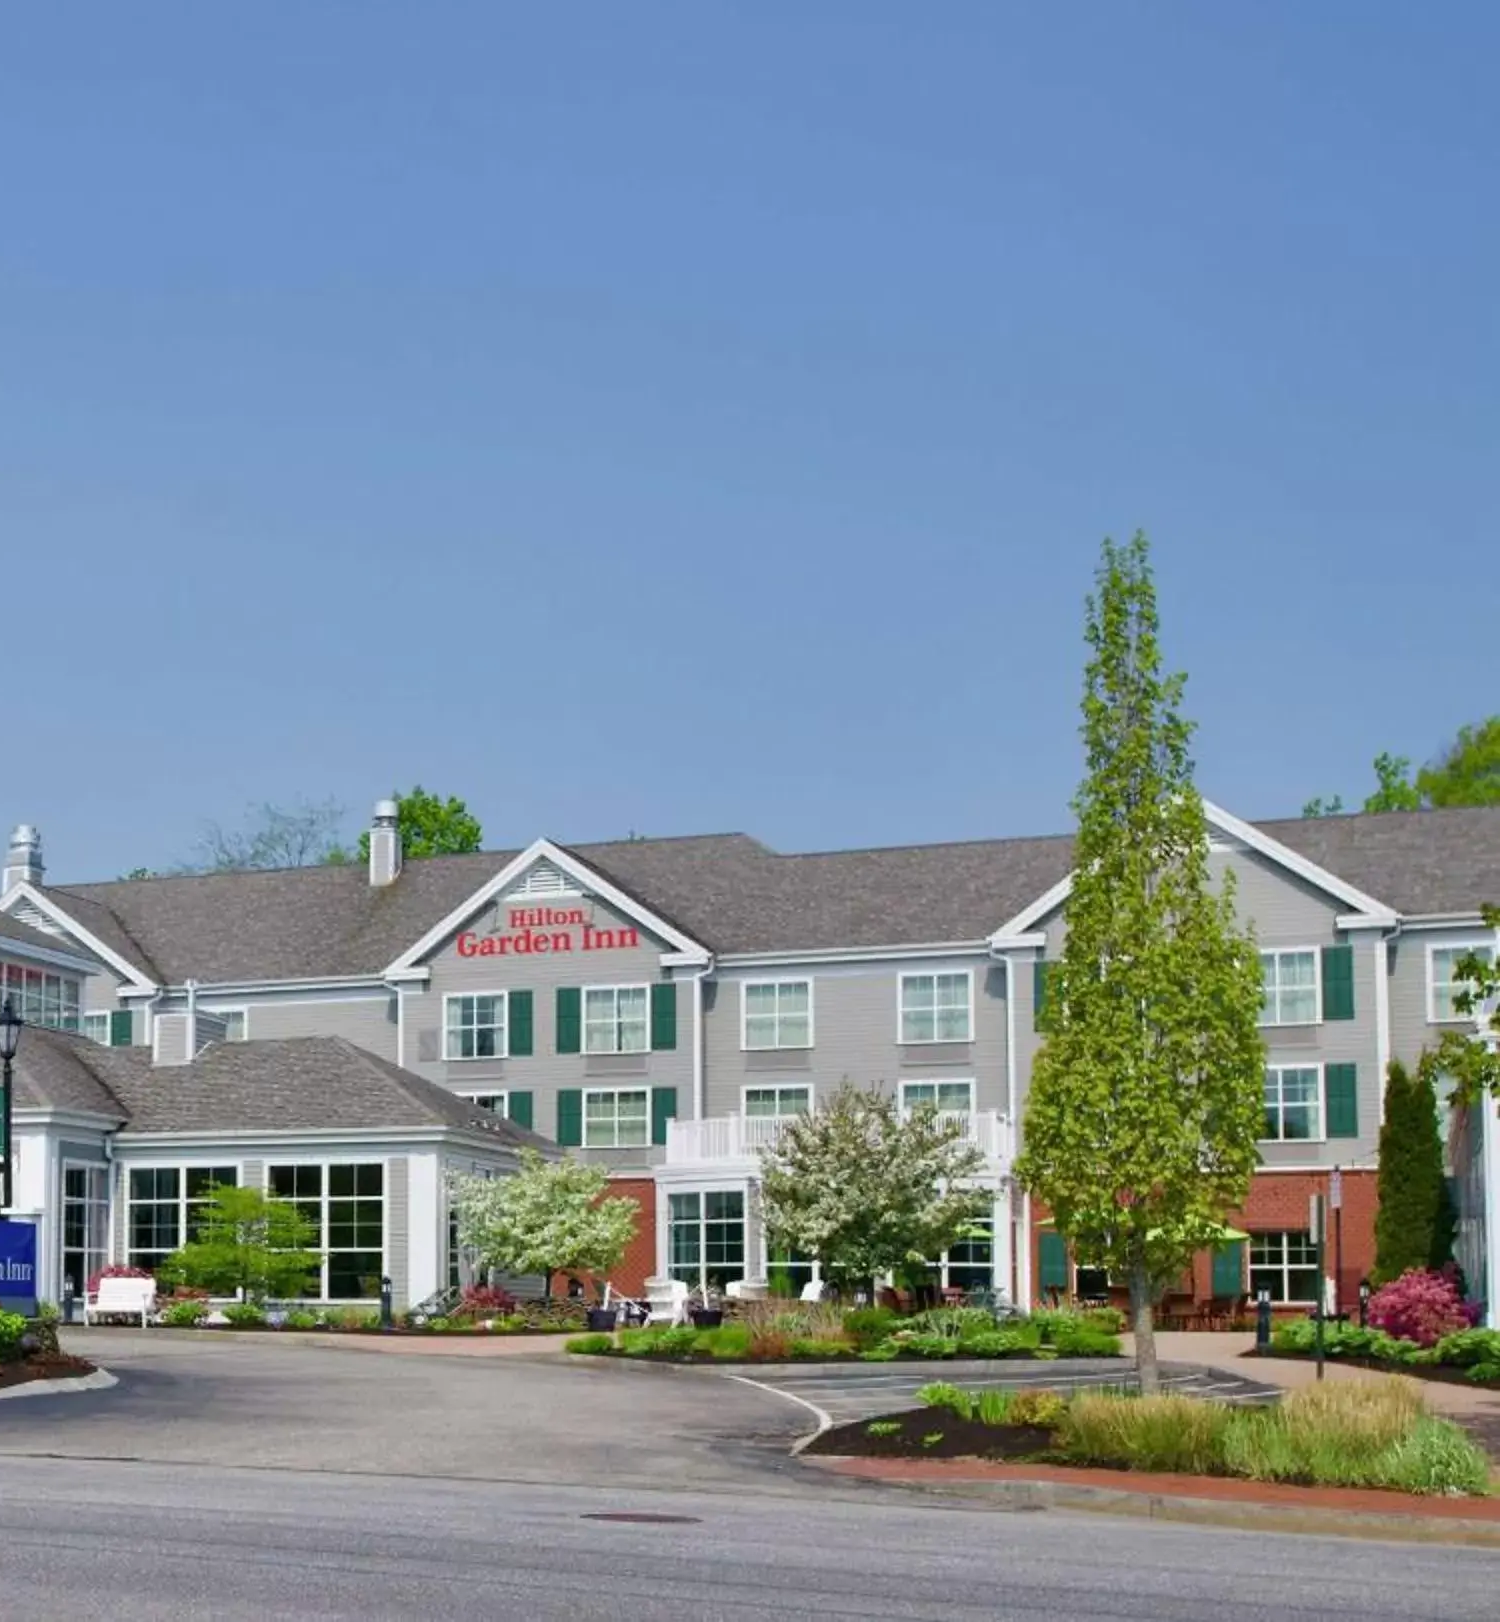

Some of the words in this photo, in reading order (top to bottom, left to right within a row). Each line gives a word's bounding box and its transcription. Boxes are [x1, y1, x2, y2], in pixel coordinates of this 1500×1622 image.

[510, 907, 584, 928] Hilton
[457, 929, 572, 957] Garden
[581, 924, 639, 950] Inn
[6, 1256, 33, 1281] Inn
